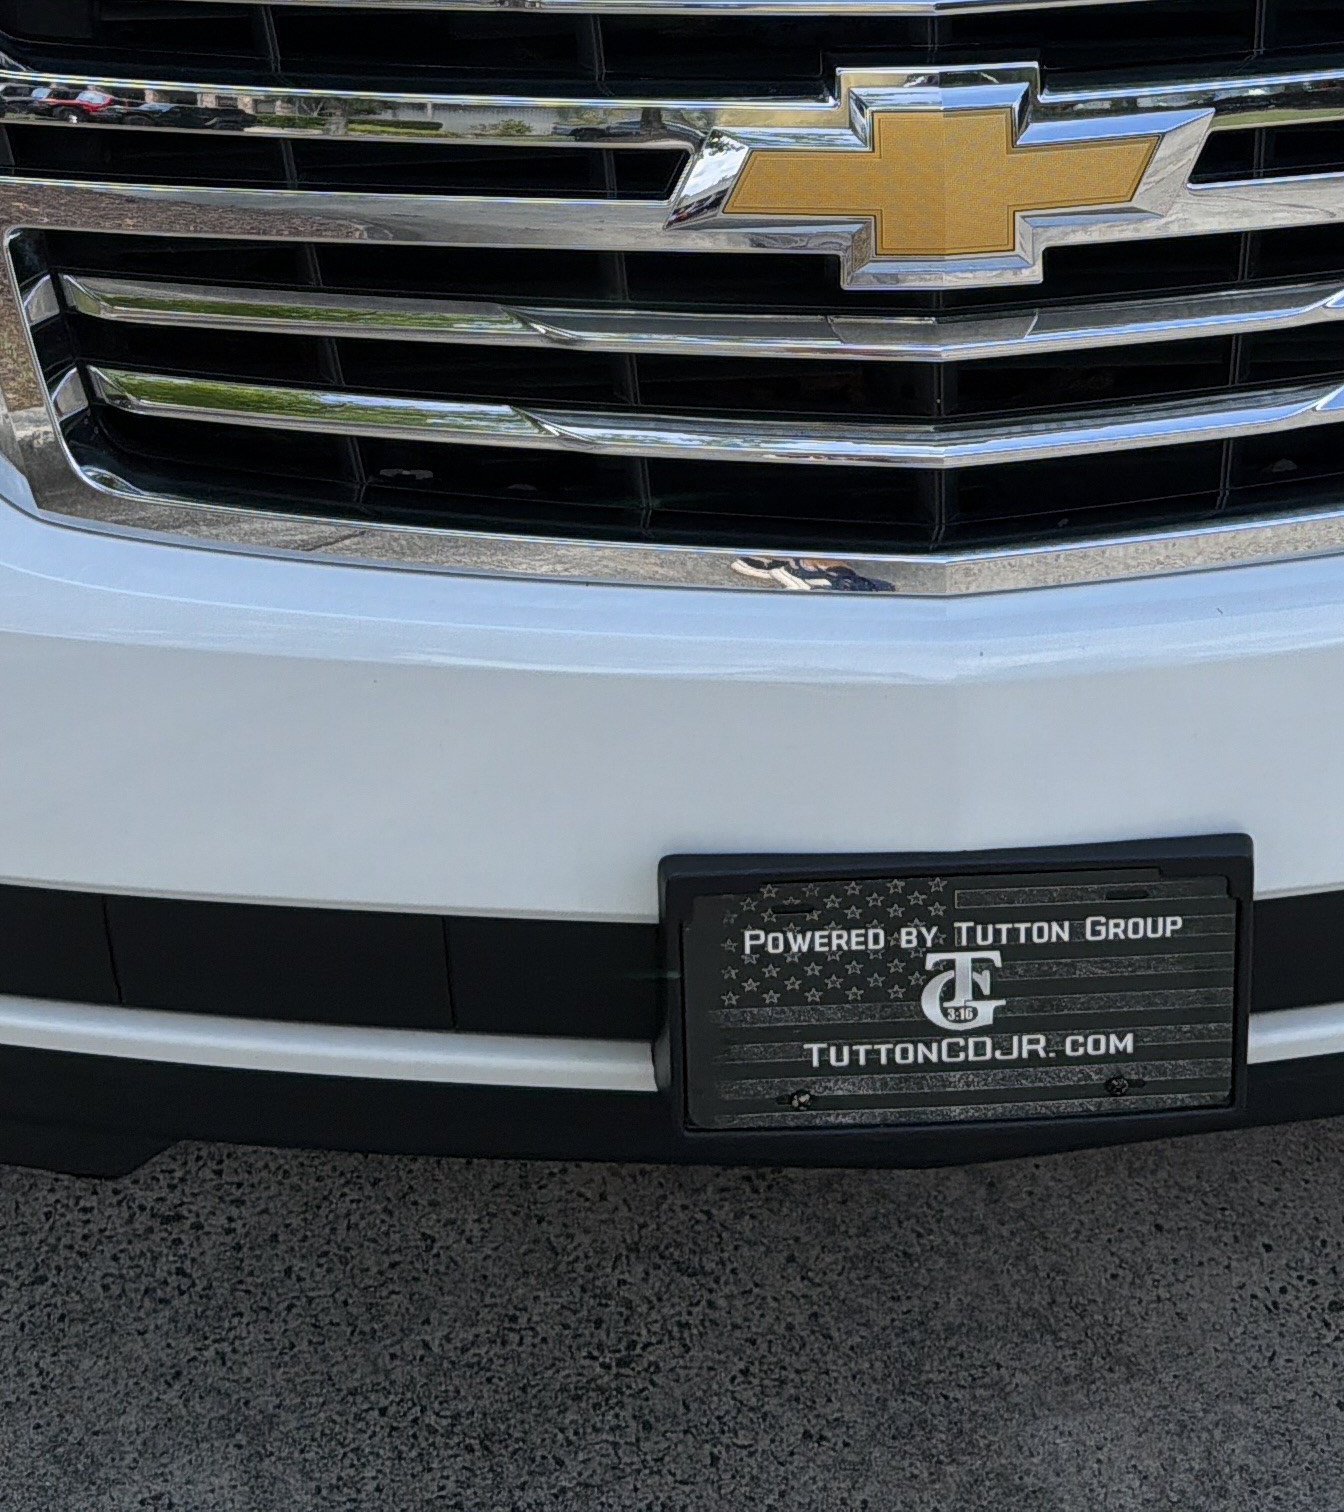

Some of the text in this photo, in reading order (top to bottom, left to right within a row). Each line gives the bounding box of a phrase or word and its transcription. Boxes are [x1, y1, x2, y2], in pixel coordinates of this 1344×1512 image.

[955, 920, 1071, 946] TUTTON
[1085, 916, 1183, 941] GROUP
[947, 1008, 973, 1021] 3:16
